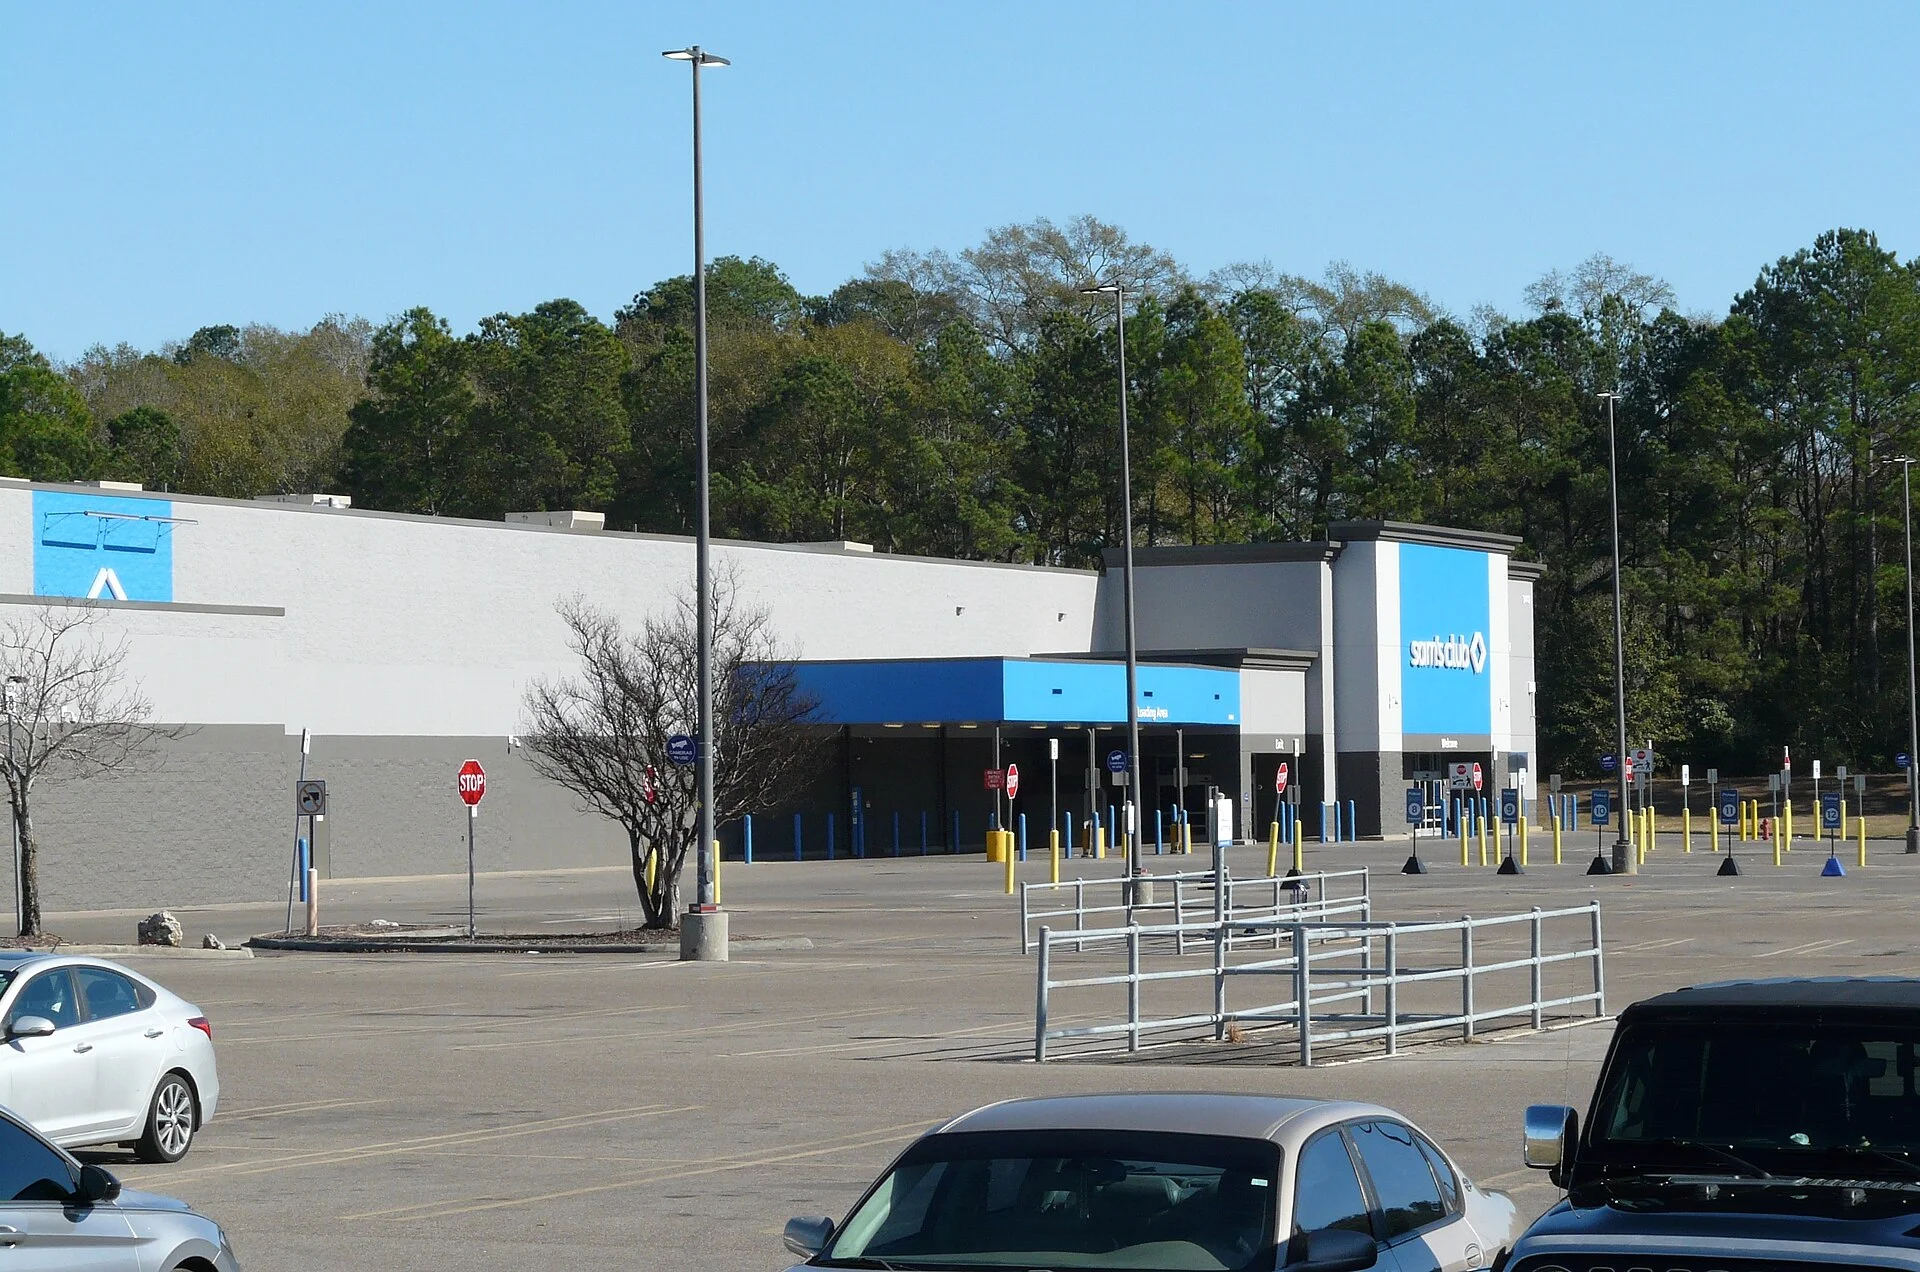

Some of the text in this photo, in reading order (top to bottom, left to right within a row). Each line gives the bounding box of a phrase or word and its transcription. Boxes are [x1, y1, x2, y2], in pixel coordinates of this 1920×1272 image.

[1444, 634, 1470, 669] club
[1137, 706, 1169, 722] Loading Area
[460, 774, 484, 792] STOP
[1008, 775, 1018, 789] STOP
[1277, 772, 1287, 784] STOP
